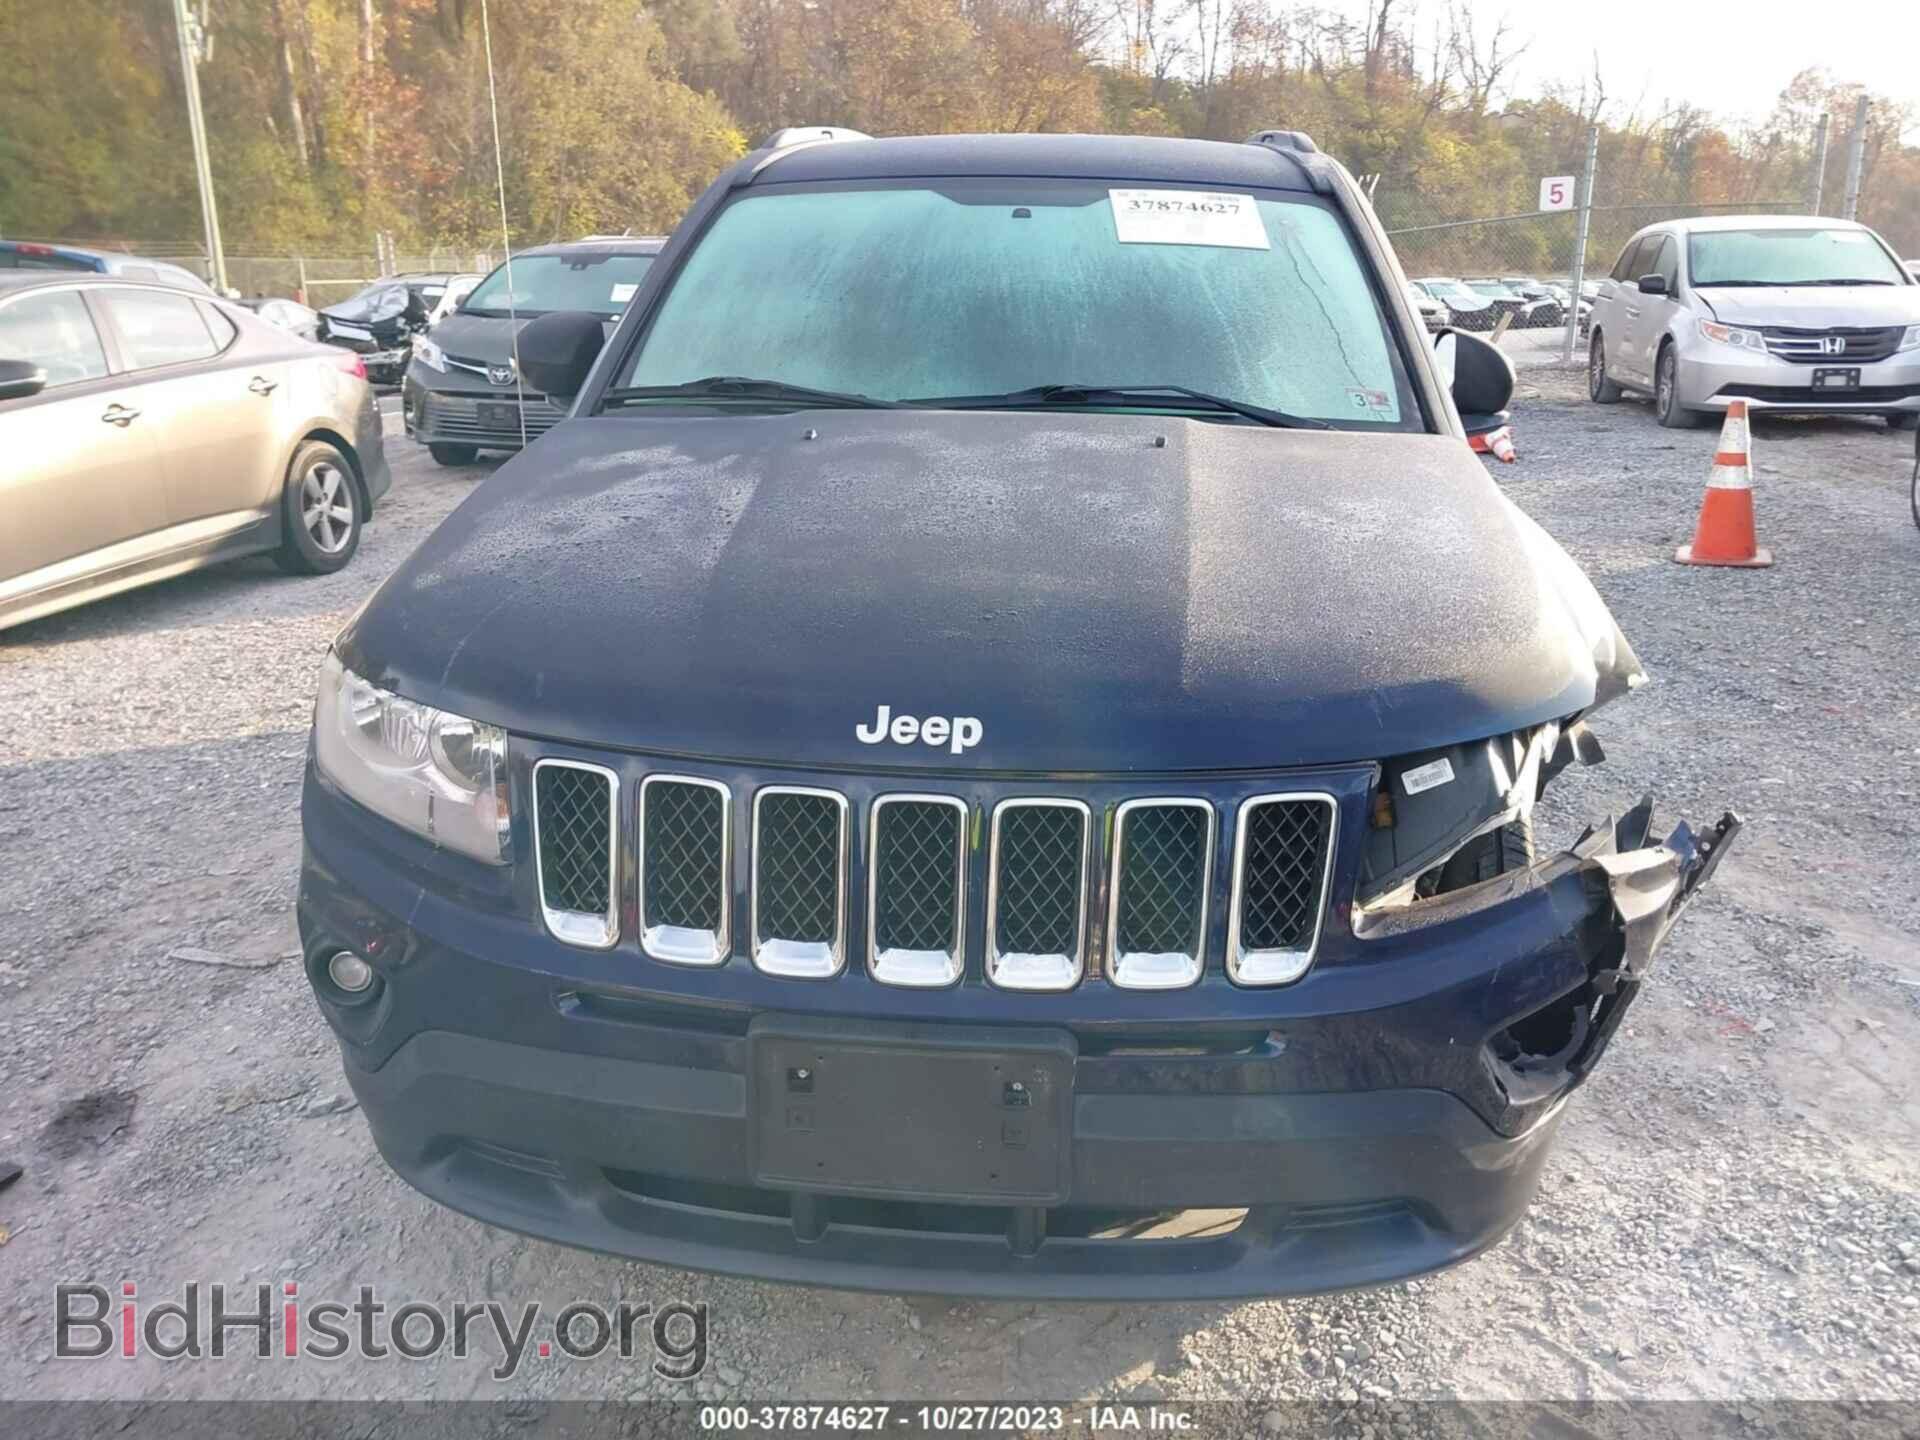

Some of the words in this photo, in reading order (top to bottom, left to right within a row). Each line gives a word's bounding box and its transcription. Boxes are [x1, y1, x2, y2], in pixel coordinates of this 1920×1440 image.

[1550, 183, 1564, 205] 5
[1128, 199, 1241, 215] 37874627
[855, 704, 984, 755] Jeep
